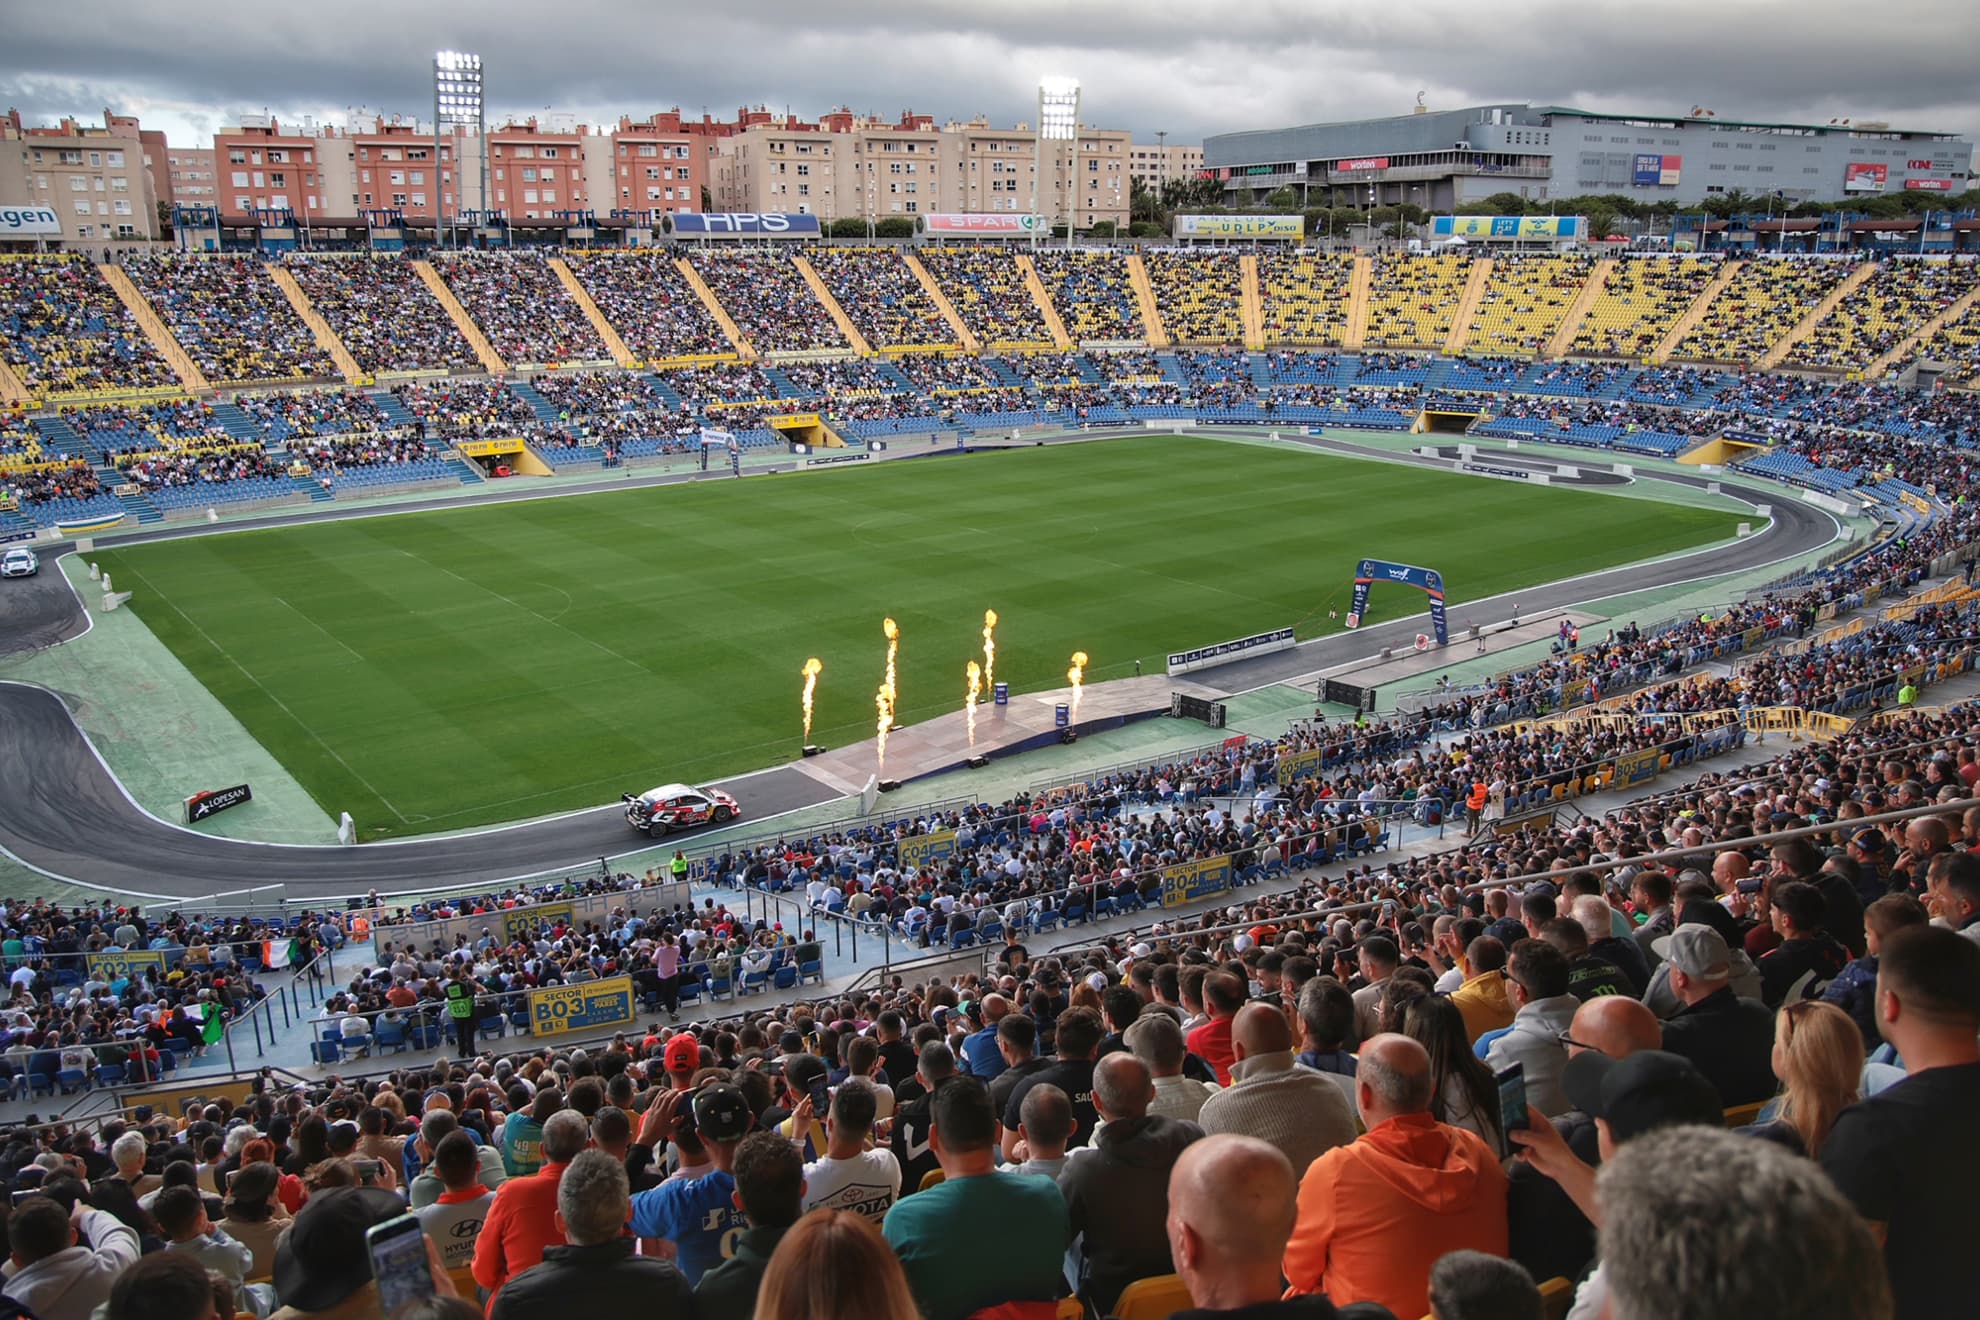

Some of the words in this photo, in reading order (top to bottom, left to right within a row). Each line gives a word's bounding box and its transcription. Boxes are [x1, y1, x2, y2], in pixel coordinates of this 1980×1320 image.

[701, 213, 790, 232] HPS
[950, 215, 1017, 227] SPAR
[209, 788, 245, 808] LOPESAN
[902, 845, 928, 860] C04
[1166, 873, 1198, 892] B04
[544, 989, 582, 1001] SECTOR
[536, 998, 585, 1020] B03
